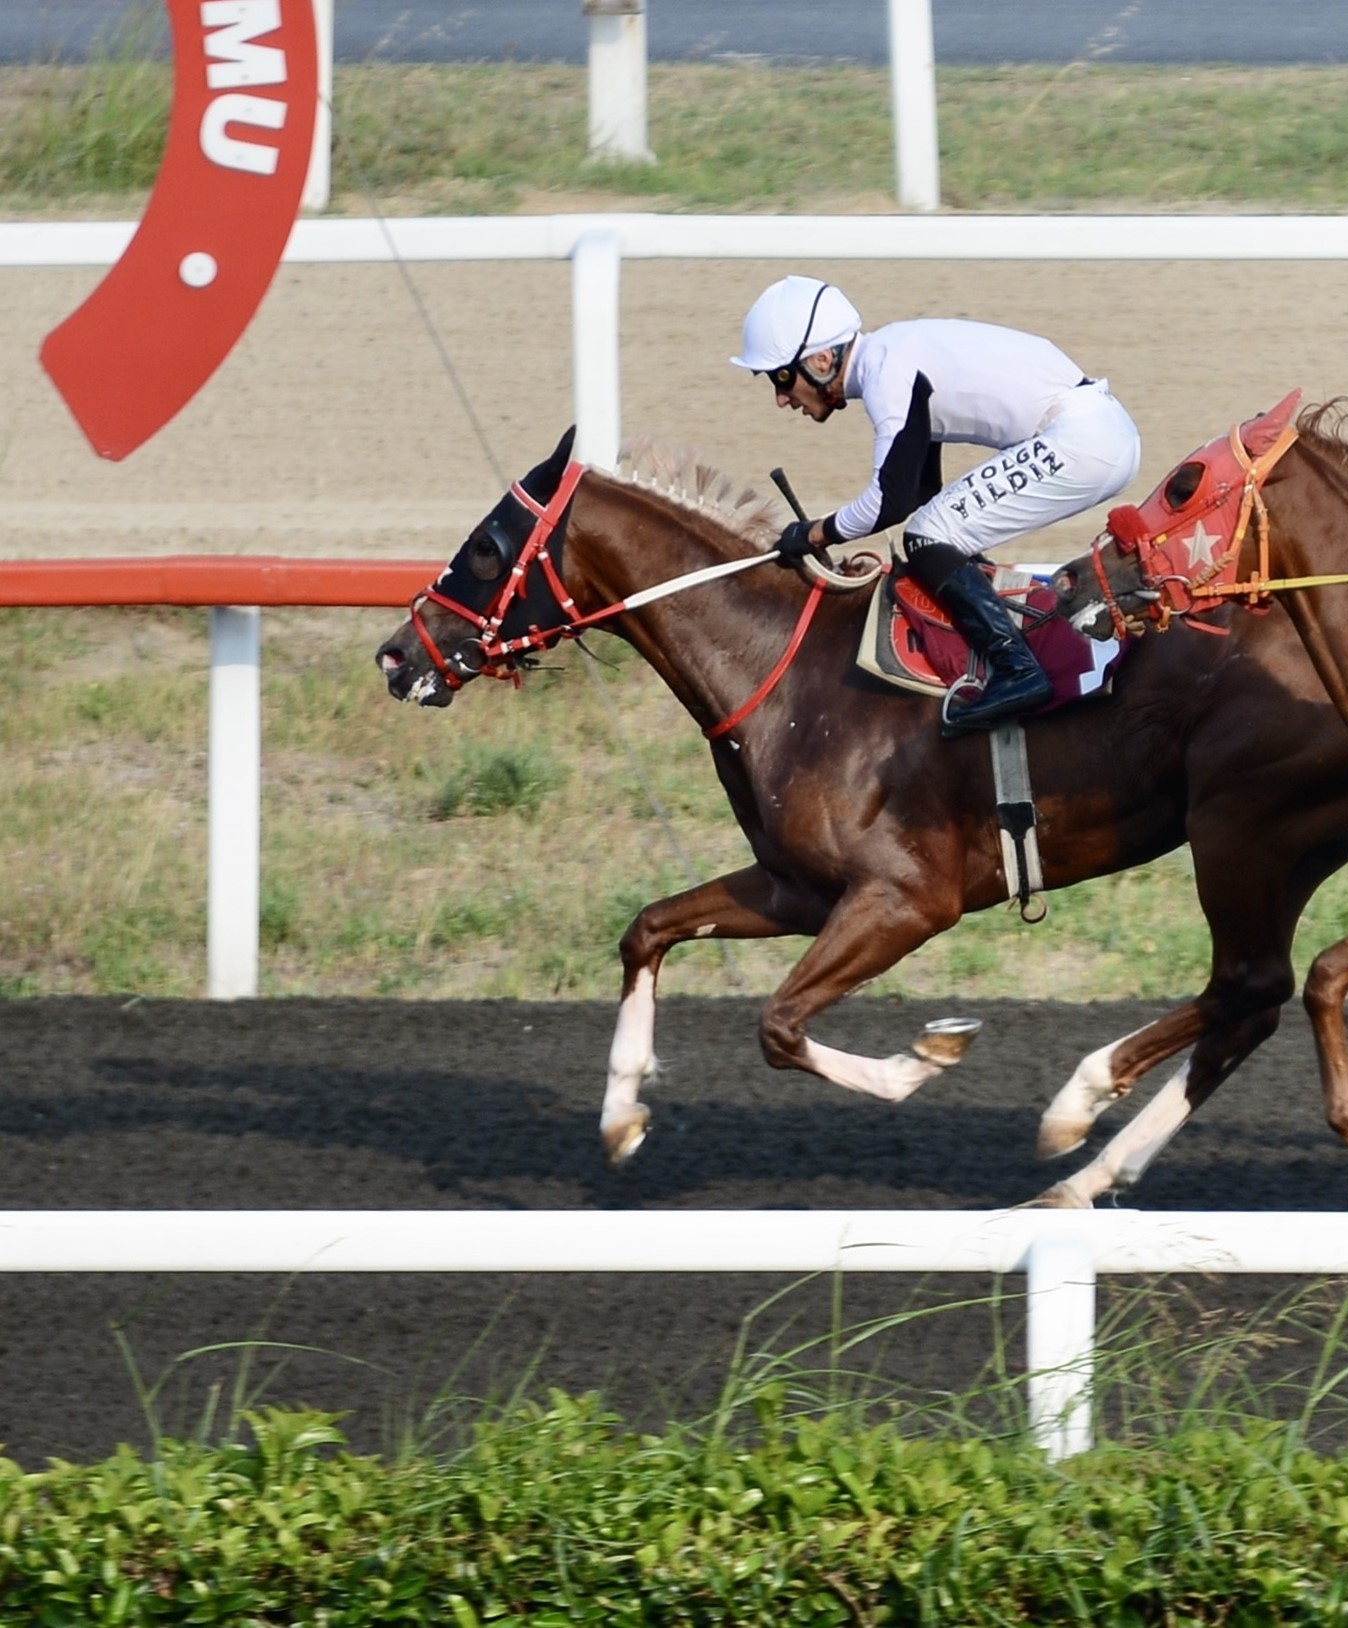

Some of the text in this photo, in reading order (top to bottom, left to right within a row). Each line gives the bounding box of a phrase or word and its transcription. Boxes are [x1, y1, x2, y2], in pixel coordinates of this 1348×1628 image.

[200, 0, 288, 177] MU
[950, 451, 1065, 519] YILDIZ
[962, 440, 1048, 489] TOLGA
[908, 537, 940, 553] T.YIL
